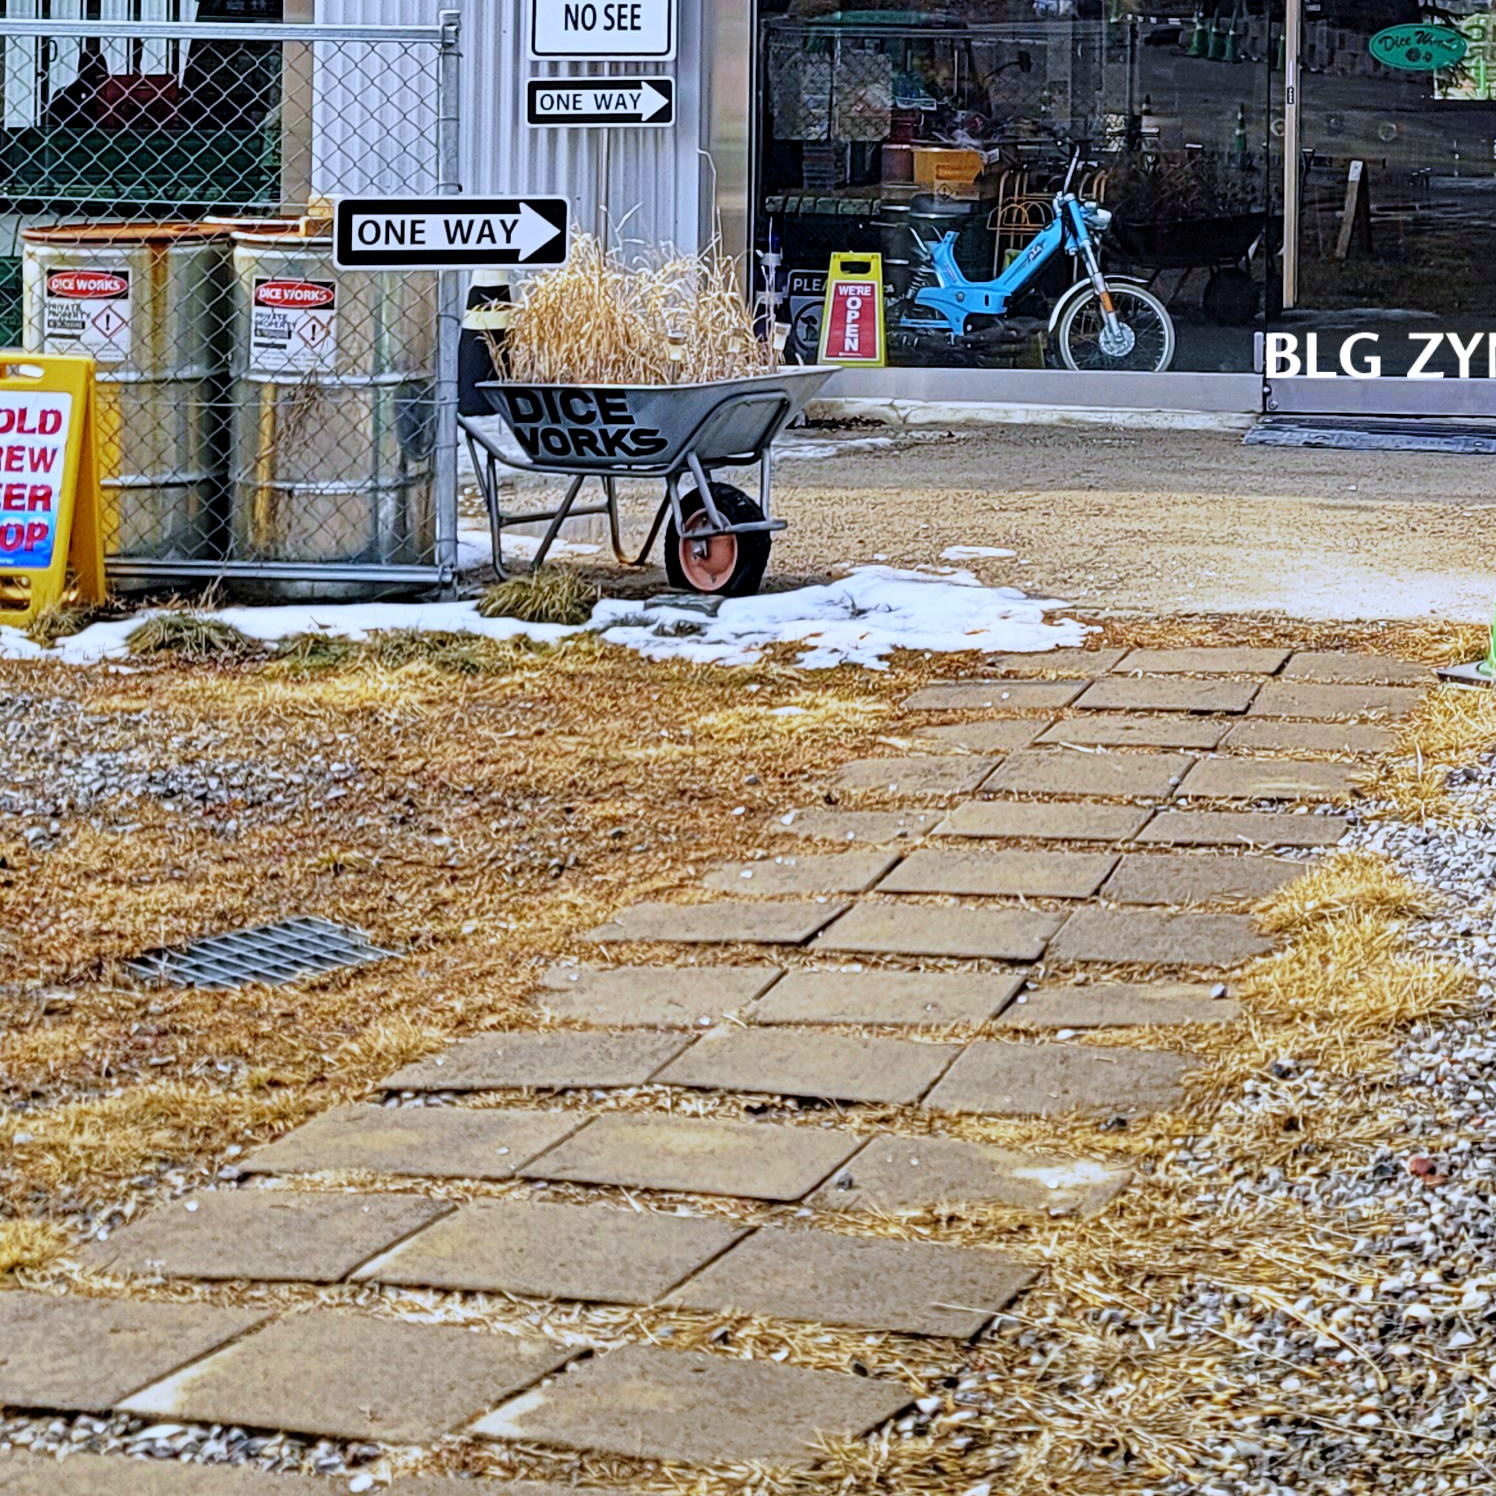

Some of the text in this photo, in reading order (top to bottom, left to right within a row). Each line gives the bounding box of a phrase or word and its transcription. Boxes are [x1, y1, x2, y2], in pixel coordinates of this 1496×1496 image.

[564, 3, 642, 31] NO SEE
[540, 93, 642, 111] ONE WAY
[357, 218, 520, 246] ONE WAY
[51, 277, 121, 292] DICE WORKS
[259, 287, 327, 301] DICE WORKS
[844, 297, 862, 352] OPEN
[503, 389, 636, 425] DICE
